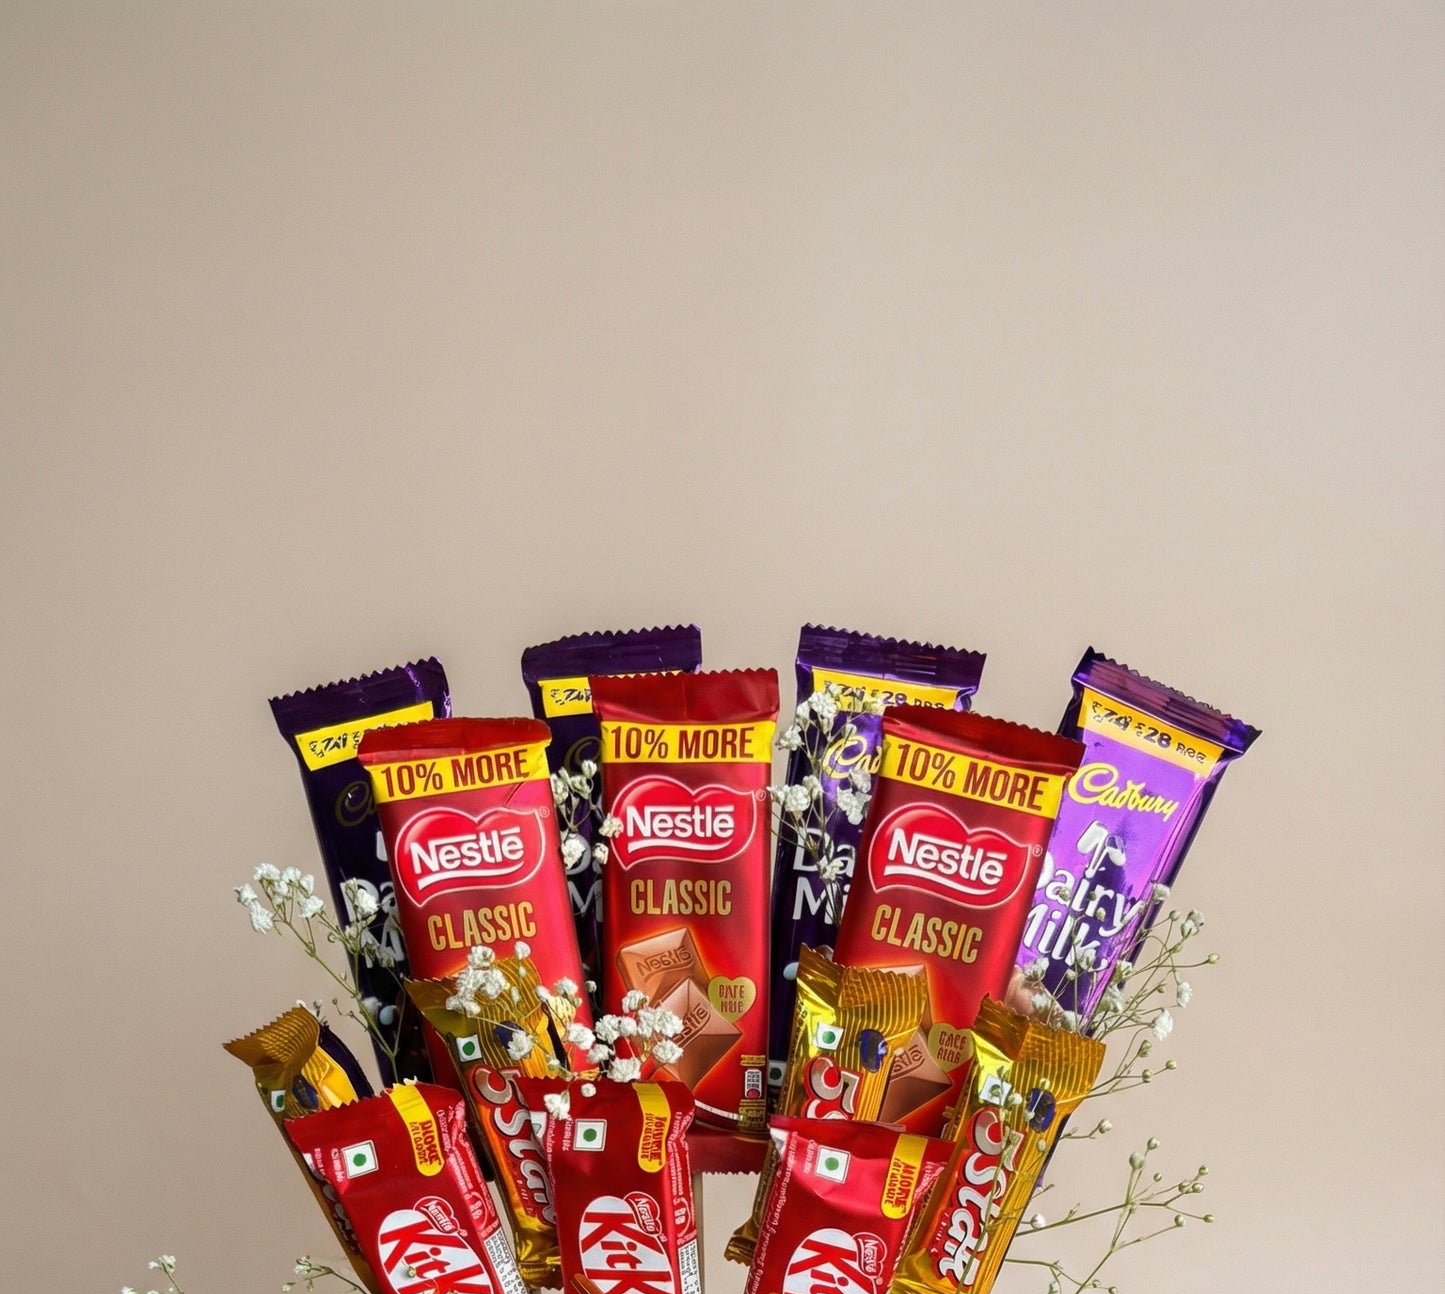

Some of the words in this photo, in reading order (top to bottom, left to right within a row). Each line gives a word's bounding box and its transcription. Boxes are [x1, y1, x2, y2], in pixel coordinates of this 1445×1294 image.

[612, 727, 668, 759] 10%
[678, 727, 754, 759] MORE
[380, 760, 444, 798] 10%
[451, 749, 530, 788] MORE
[896, 743, 956, 789] 10%
[963, 769, 1049, 812] MORE
[1068, 762, 1180, 823] Cadbury
[626, 805, 735, 838] Nestlé
[410, 827, 524, 875] Nestlé
[887, 828, 1008, 885] Nestlé
[630, 879, 732, 915] CLASSIC
[427, 901, 537, 951] CLASSIC
[871, 904, 983, 964] CLASSIC
